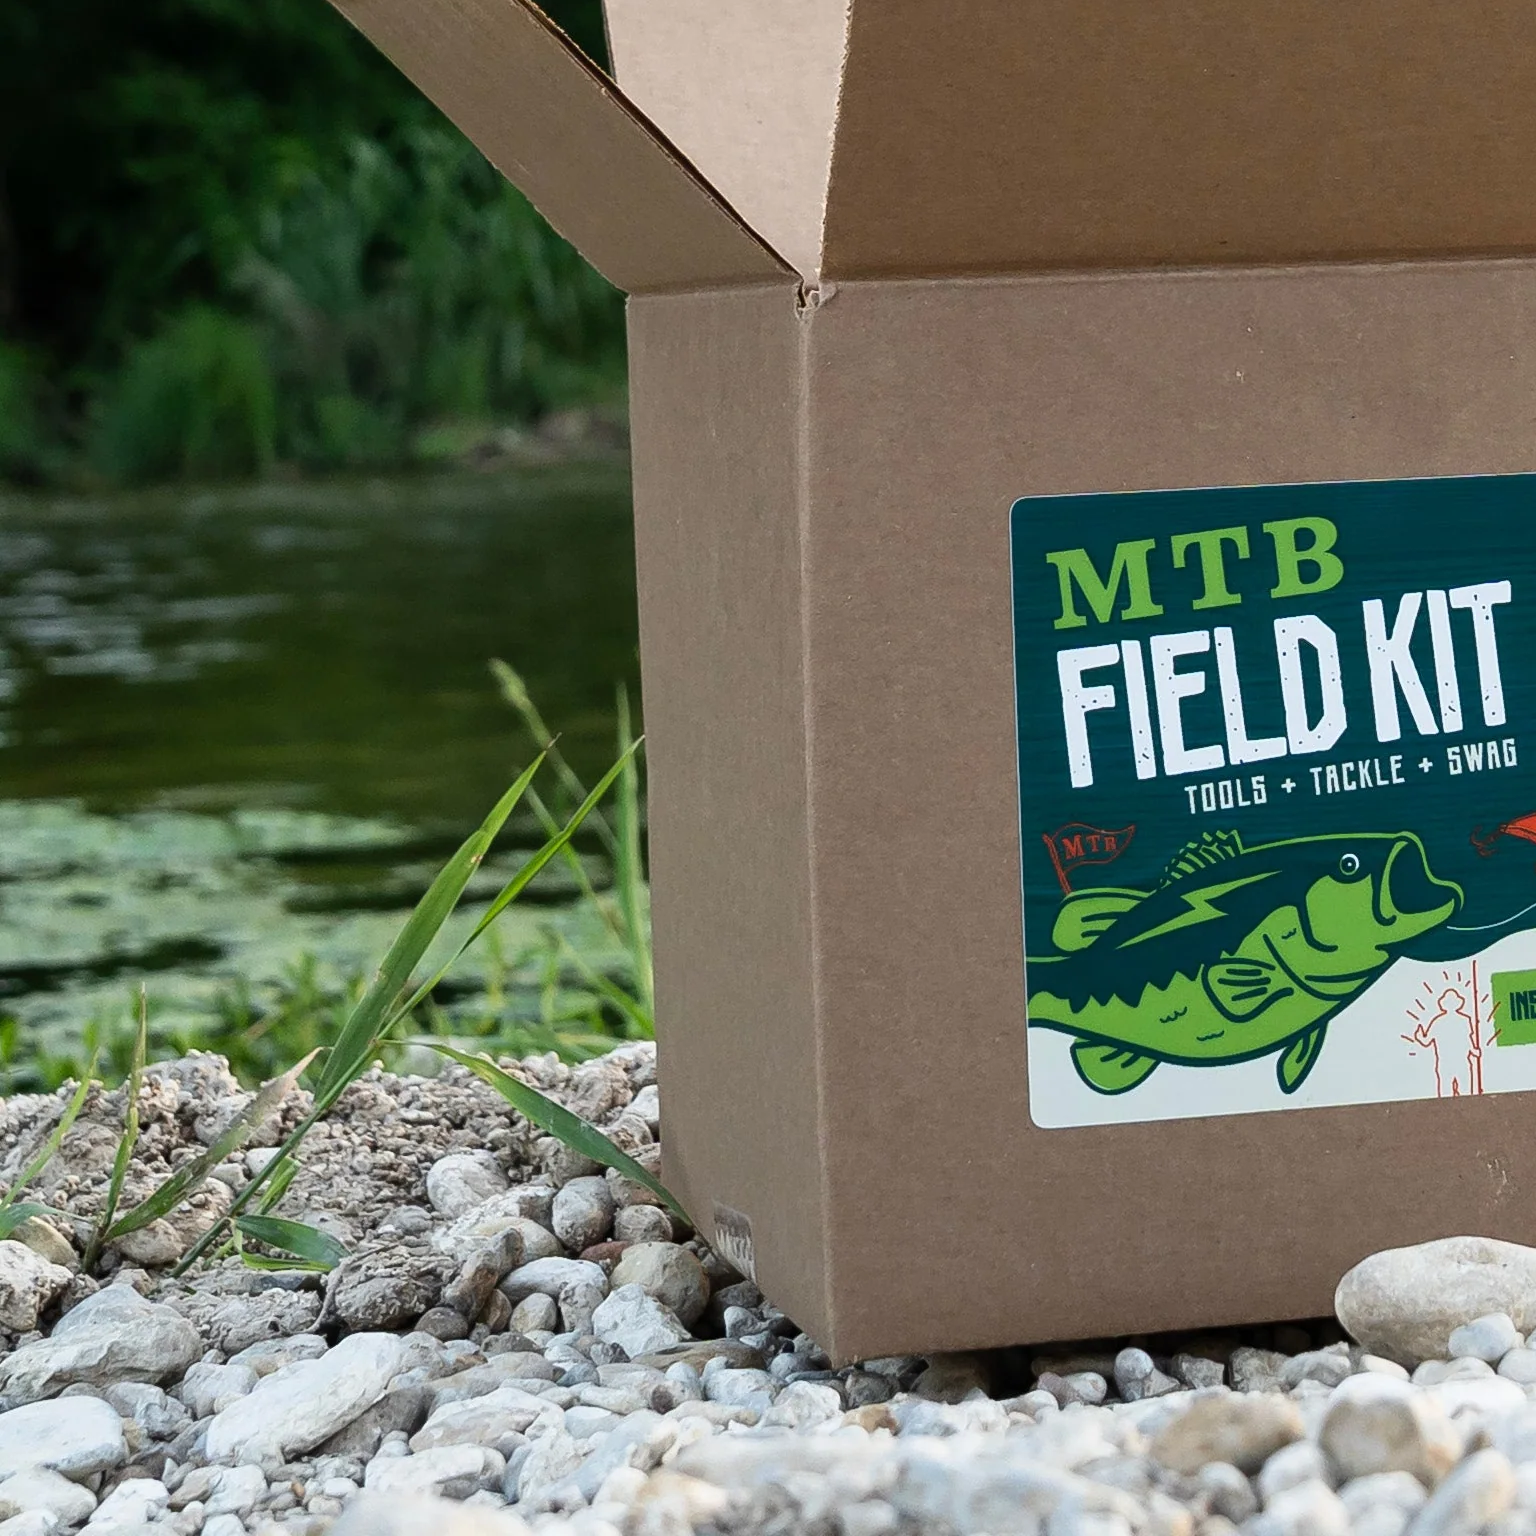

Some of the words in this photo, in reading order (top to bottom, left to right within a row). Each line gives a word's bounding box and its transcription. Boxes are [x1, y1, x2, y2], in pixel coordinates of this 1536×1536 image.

[1046, 516, 1345, 630] MTB
[1056, 614, 1348, 788] FIELD
[1361, 579, 1512, 743] KIT
[1184, 775, 1268, 814] TOOLS
[1309, 754, 1406, 796] TACKLE
[1447, 738, 1518, 776] SWAG
